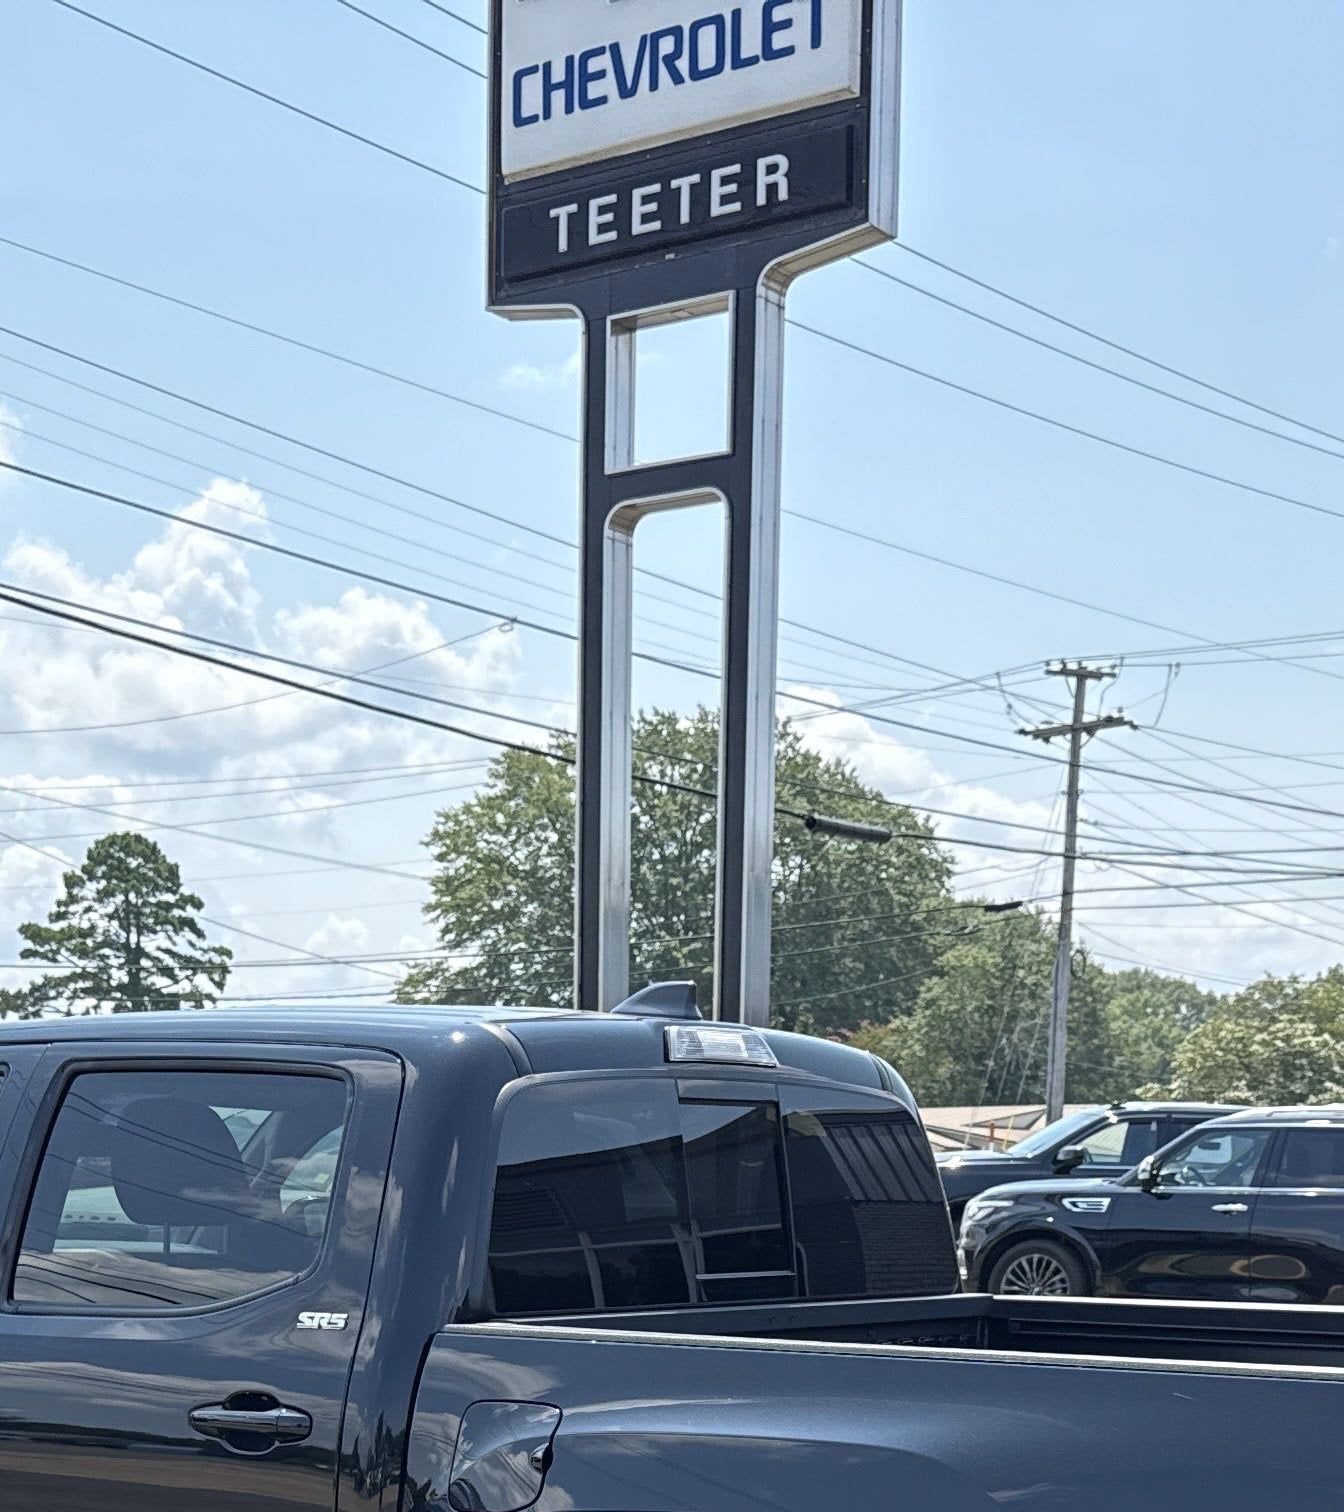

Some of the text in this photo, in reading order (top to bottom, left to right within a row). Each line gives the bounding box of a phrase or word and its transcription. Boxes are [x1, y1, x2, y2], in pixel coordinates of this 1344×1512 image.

[512, 0, 822, 128] CHEVROLET
[549, 153, 790, 253] TEETER
[296, 1311, 348, 1330] SR5
